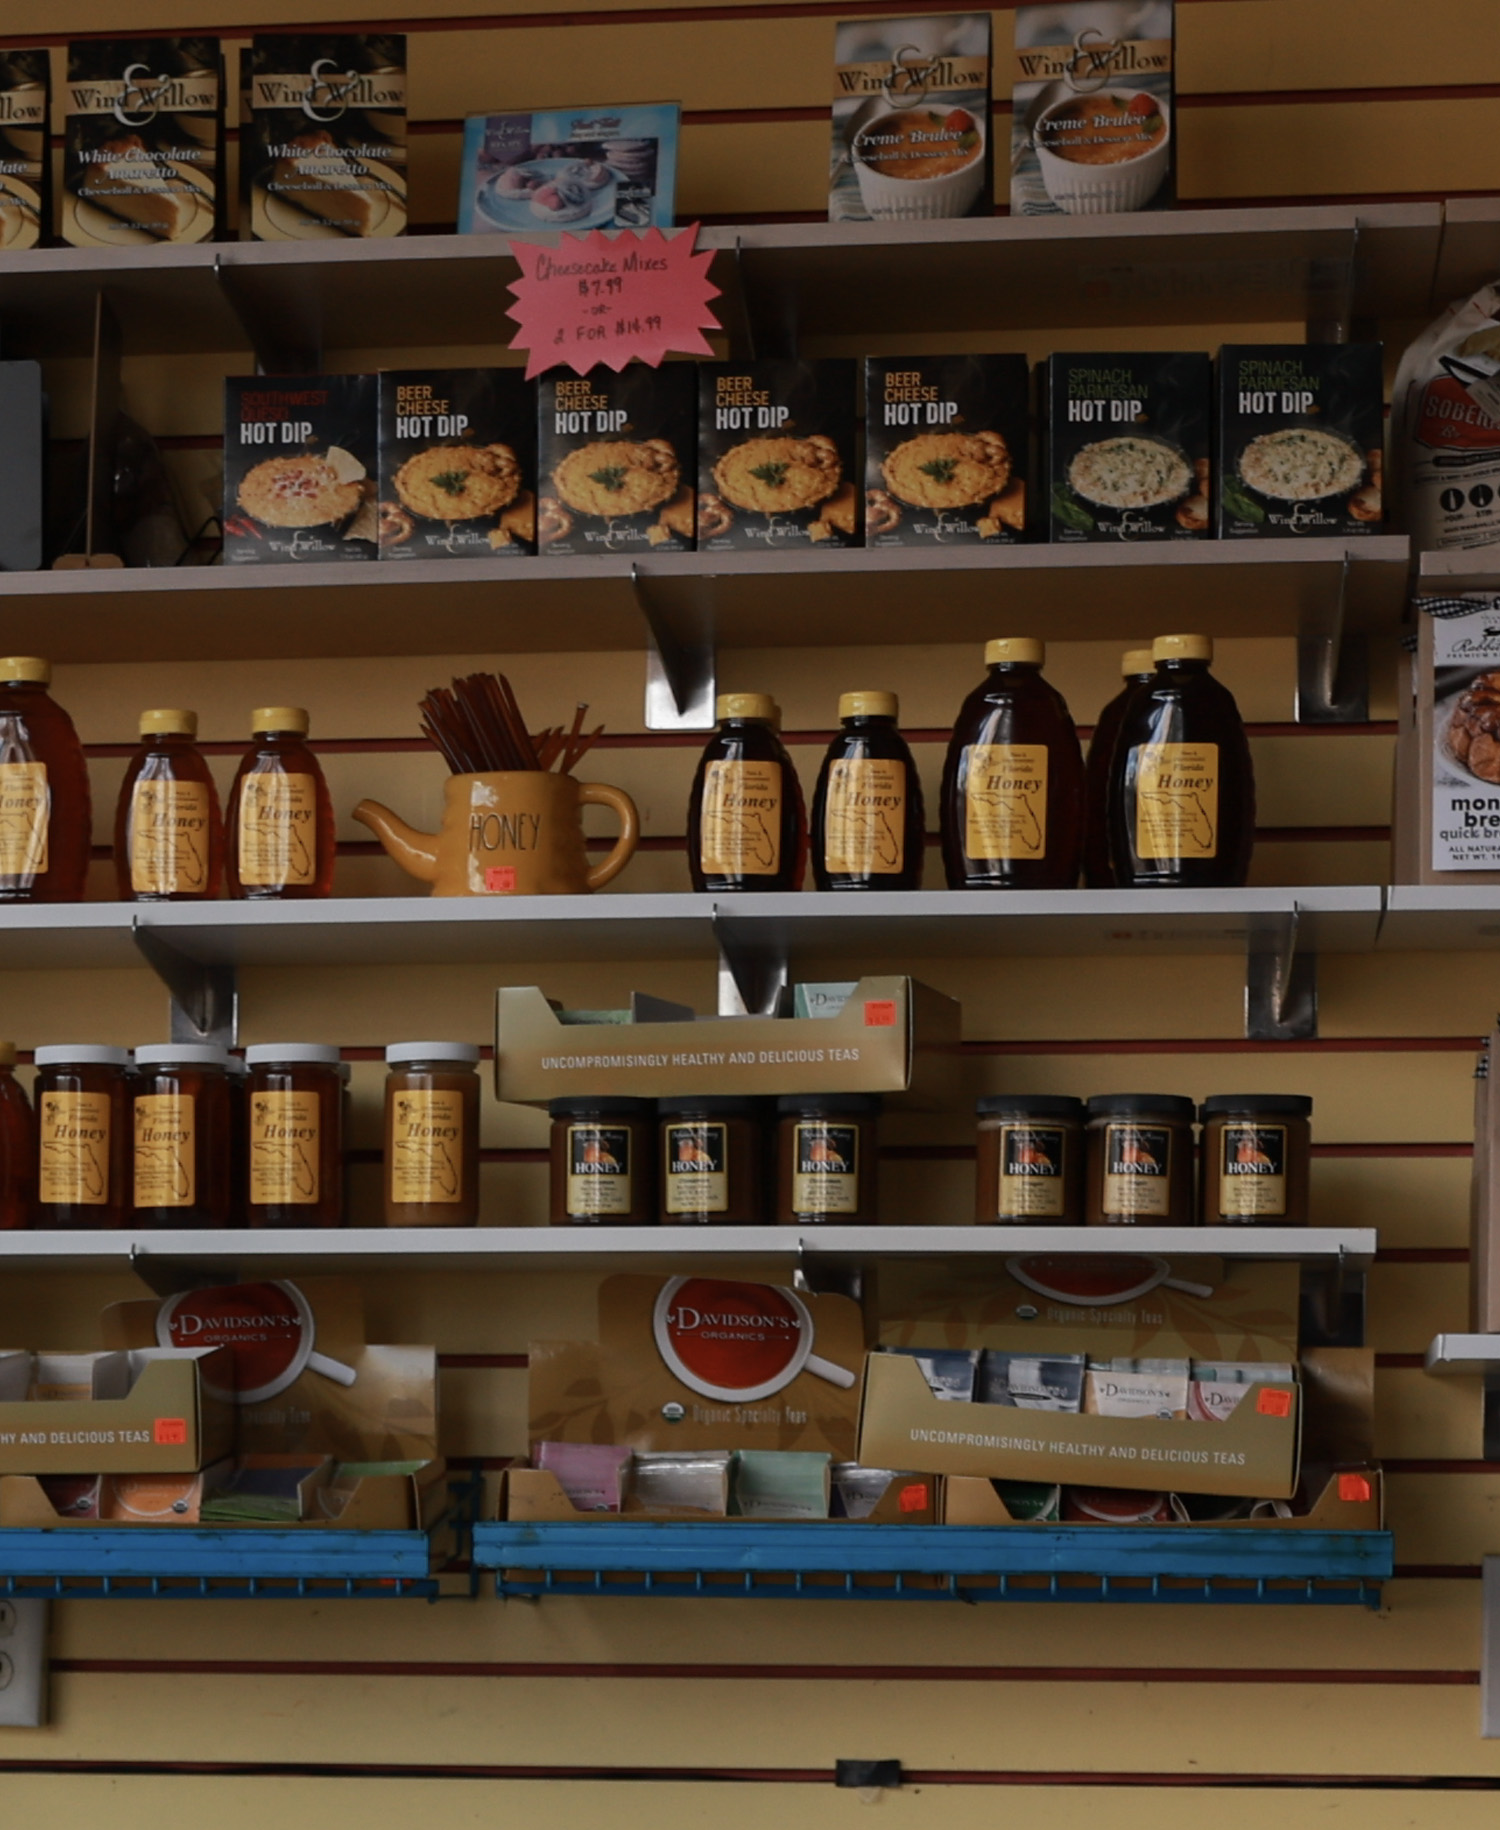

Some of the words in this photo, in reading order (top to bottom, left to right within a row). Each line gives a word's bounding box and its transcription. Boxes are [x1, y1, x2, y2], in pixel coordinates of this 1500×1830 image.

[1035, 116, 1087, 132] Creme
[853, 132, 904, 148] Creme
[535, 254, 617, 281] Cheesecake
[622, 250, 668, 272] Mixes
[576, 326, 606, 341] FOR
[1238, 360, 1302, 375] SPINACH
[715, 376, 753, 392] BEER
[884, 371, 921, 387] BEER
[1068, 368, 1132, 384] SPINACH
[1238, 376, 1320, 391] PARMESAN
[396, 385, 433, 401] BEER
[555, 381, 592, 396] BEER
[884, 386, 938, 402] CHEESE
[1068, 384, 1148, 399] PARMESAN
[555, 395, 608, 411] CHEESE
[715, 391, 769, 407] CHEESE
[1238, 393, 1275, 414] HOT
[1281, 392, 1313, 414] DIP
[396, 400, 449, 415] CHEESE
[884, 403, 922, 426] HOT
[927, 402, 958, 424] DIP
[1068, 401, 1104, 422] HOT
[1110, 401, 1142, 422] DIP
[555, 411, 592, 434] HOT
[597, 410, 628, 432] DIP
[715, 407, 753, 430] HOT
[758, 406, 790, 428] DIP
[240, 422, 276, 445] HOT
[281, 422, 313, 444] DIP
[396, 416, 431, 439] HOT
[438, 415, 469, 437] DIP
[469, 812, 541, 852] HONEY
[1439, 827, 1480, 841] quick
[541, 1054, 670, 1070] UNCOMPROMISINGLY
[672, 1053, 725, 1067] HEALTHY
[728, 1051, 756, 1064] AND
[758, 1049, 825, 1064] DELICIOUS
[829, 1048, 860, 1062] TEAS
[142, 1127, 190, 1143] Honey
[264, 1123, 317, 1141] Honey
[407, 1122, 460, 1140] Honey
[575, 1161, 623, 1174] HONEY
[672, 1160, 718, 1173] HONEY
[802, 1160, 849, 1173] HONEY
[1008, 1162, 1056, 1175] HONEY
[1113, 1161, 1160, 1175] HONEY
[1228, 1161, 1277, 1175] HONEY
[180, 1313, 290, 1337] DAVIDSON'S
[677, 1306, 789, 1330] DAVIDSON'S
[203, 1333, 267, 1343] ORGANICS
[19, 1431, 46, 1444] AND
[50, 1430, 115, 1444] DELICIOUS
[119, 1430, 150, 1443] TEAS
[910, 1429, 1045, 1453] UNCOMPROMISINGLY
[1049, 1441, 1106, 1458] HEALTHY
[1109, 1446, 1137, 1461] AND
[1140, 1447, 1208, 1464] DELICIOUS
[1212, 1452, 1246, 1466] TEAS
